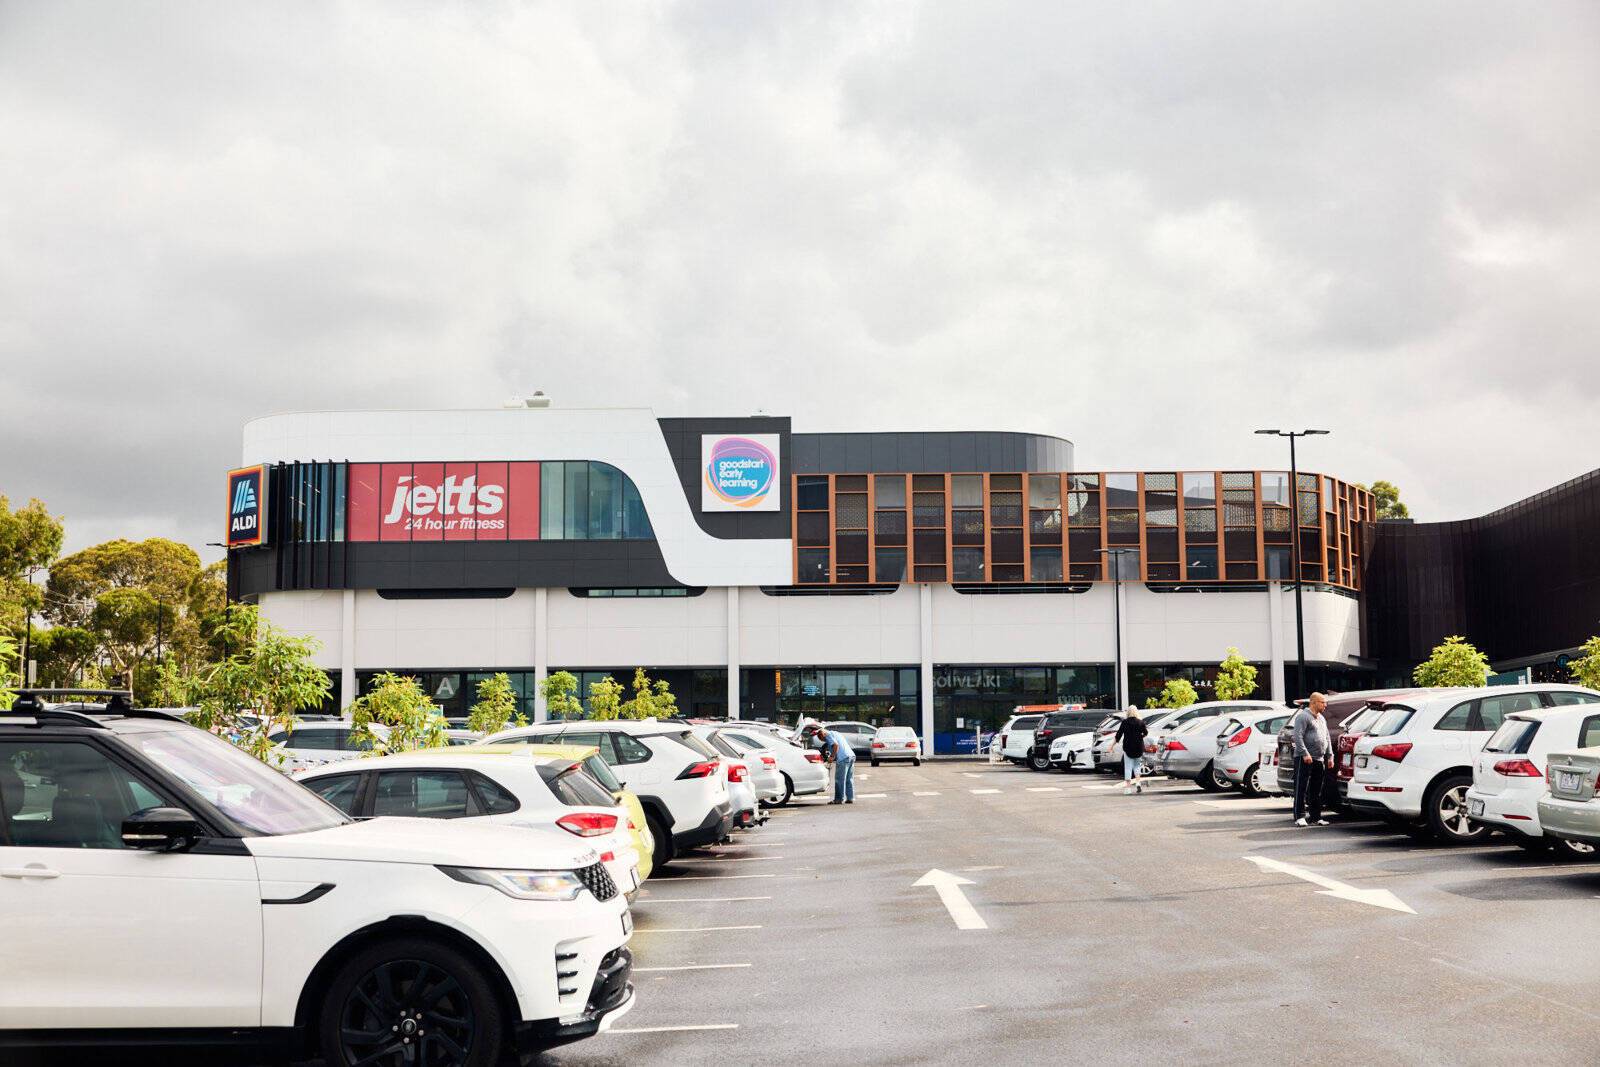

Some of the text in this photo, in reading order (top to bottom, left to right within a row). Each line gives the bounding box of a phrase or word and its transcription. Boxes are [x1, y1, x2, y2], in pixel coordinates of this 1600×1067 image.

[719, 459, 764, 471] goodstart
[719, 469, 742, 479] early
[719, 478, 757, 489] learning
[384, 475, 505, 524] jetts
[231, 514, 257, 532] ALDI
[404, 518, 505, 530] 24 hour fitness
